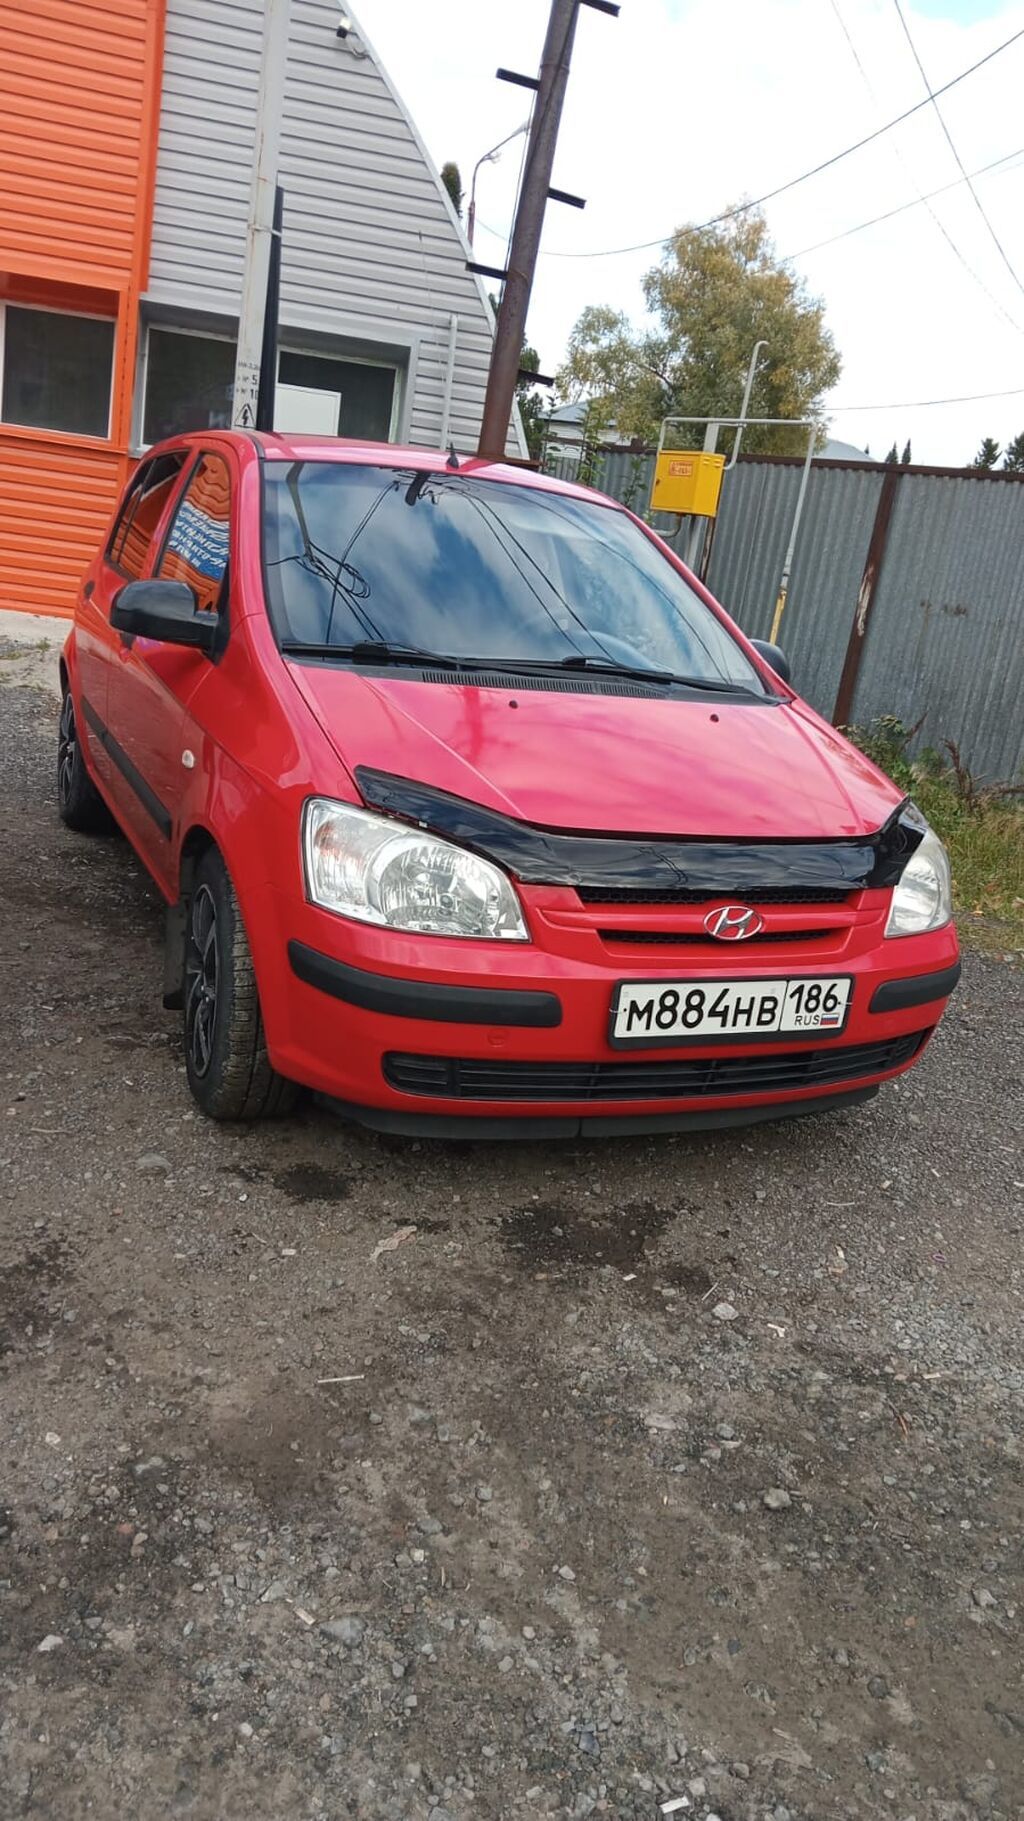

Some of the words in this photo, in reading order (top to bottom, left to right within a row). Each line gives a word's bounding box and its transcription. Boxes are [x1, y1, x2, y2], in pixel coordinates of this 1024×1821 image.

[626, 988, 778, 1031] М884НВ
[789, 983, 839, 1014] 186
[794, 1014, 820, 1026] RUS
